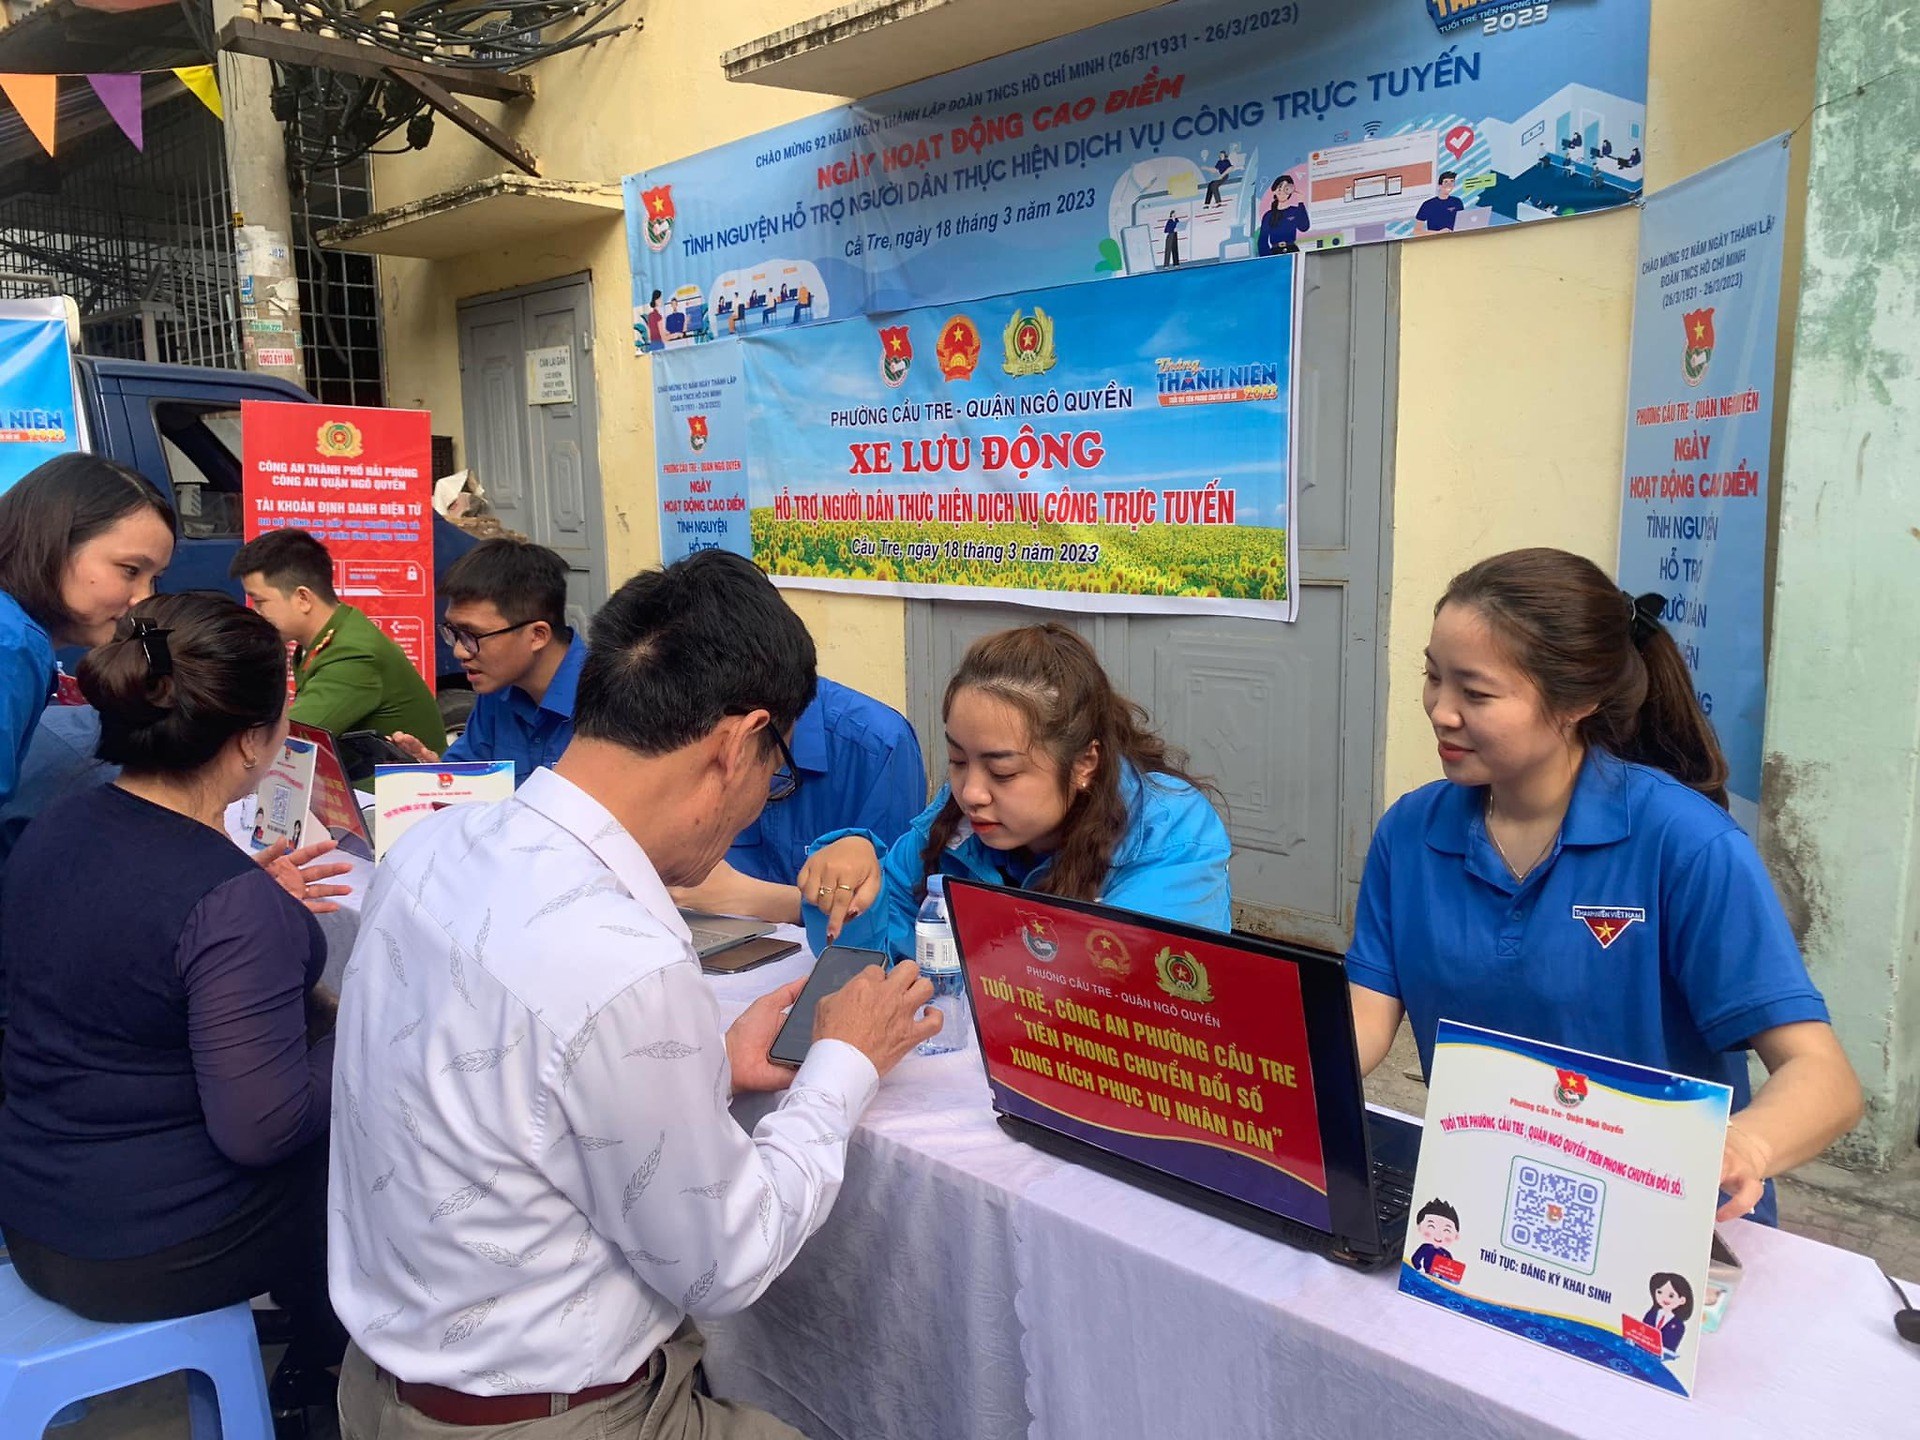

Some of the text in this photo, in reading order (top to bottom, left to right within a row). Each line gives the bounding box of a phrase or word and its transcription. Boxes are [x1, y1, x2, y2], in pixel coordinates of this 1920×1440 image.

[1483, 4, 1549, 35] 2023
[755, 146, 782, 168] CHÀO
[783, 137, 812, 160] MỪNG
[814, 137, 827, 152] 92
[828, 125, 851, 146] NĂM
[852, 115, 881, 139] NGÀY
[921, 101, 947, 123] LẬP
[986, 80, 1020, 101] TNCS
[1021, 70, 1041, 95] HỒ
[1042, 64, 1067, 88] CHÍ
[1068, 55, 1106, 81] MINH
[1108, 32, 1189, 73] (26/3/1931
[1205, 2, 1299, 43] 26/3/2023)
[682, 232, 716, 259] TÌNH
[715, 214, 780, 251] NGUYỆN
[781, 200, 807, 235] HỖ
[810, 196, 847, 226] TRỢ
[906, 176, 949, 205] DÂN
[952, 158, 1008, 193] THỰC
[1011, 146, 1060, 181] HIỆN
[1063, 129, 1123, 169] DỊCH
[1128, 119, 1166, 154] VỤ
[1171, 100, 1265, 141] CÔNG
[1272, 80, 1358, 122] TRỰC
[1366, 44, 1481, 102] TUYẾN
[817, 149, 877, 190] NGÀY
[881, 132, 945, 170] HOẠT
[951, 112, 1025, 155] ĐỘNG
[1031, 95, 1097, 133] CAO
[867, 188, 1096, 253] Tre, ngày 18 tháng 3 năm 2023
[1726, 248, 1747, 267] MINH
[830, 403, 889, 428] PHƯỜNG
[924, 402, 954, 421] TRE
[966, 393, 1016, 421] QUẬN
[1020, 388, 1059, 415] NGÔ
[1063, 380, 1133, 412] QUYỀN
[849, 424, 1105, 479] XE LƯU ĐỘNG
[1674, 429, 1711, 462] NGÀY
[258, 460, 288, 473] CÔNG
[290, 463, 305, 474] AN
[307, 462, 341, 476] THÀNH
[272, 475, 301, 487] CÔNG
[303, 478, 319, 488] AN
[321, 477, 349, 491] QUẬN
[350, 477, 372, 490] NGÔ
[1629, 475, 1659, 504] HOẠT
[1660, 467, 1696, 504] ĐỘNG
[255, 497, 406, 516] TÀI KHOẢN ĐỊNH DANH ĐIỆN
[707, 499, 725, 512] CAO
[774, 478, 1236, 532] HỖ TRỢ NGƯỜI DÂN THỰC HIỆN DỊCH VỤ CÔNG TRỰC TUYẾN
[1646, 509, 1671, 539] TÌNH
[880, 538, 1100, 564] Tre, ngày 18 tháng 3 năm 2023
[1659, 546, 1680, 581] HỖ
[1093, 984, 1113, 998] TRE
[1055, 998, 1101, 1030] CÔNG
[1105, 1013, 1131, 1039] AN
[1132, 1020, 1210, 1063] PHƯỜNG
[1258, 1056, 1298, 1089] TRE
[1062, 1032, 1121, 1069] PHONG
[1122, 1050, 1195, 1092] CHUYỂN
[1236, 1084, 1264, 1114] SỐ
[1009, 1046, 1054, 1078] XUNG
[1055, 1060, 1096, 1092] KÍCH
[1096, 1075, 1144, 1109] PHỤC
[1147, 1090, 1172, 1121] VỤ
[1174, 1101, 1228, 1137] NHÂN
[1602, 1155, 1628, 1178] PHONG
[1499, 1255, 1519, 1272] TỤC:
[1520, 1262, 1546, 1282] ĐĂNG
[1562, 1276, 1586, 1296] KHAI
[1587, 1285, 1613, 1305] SINH
